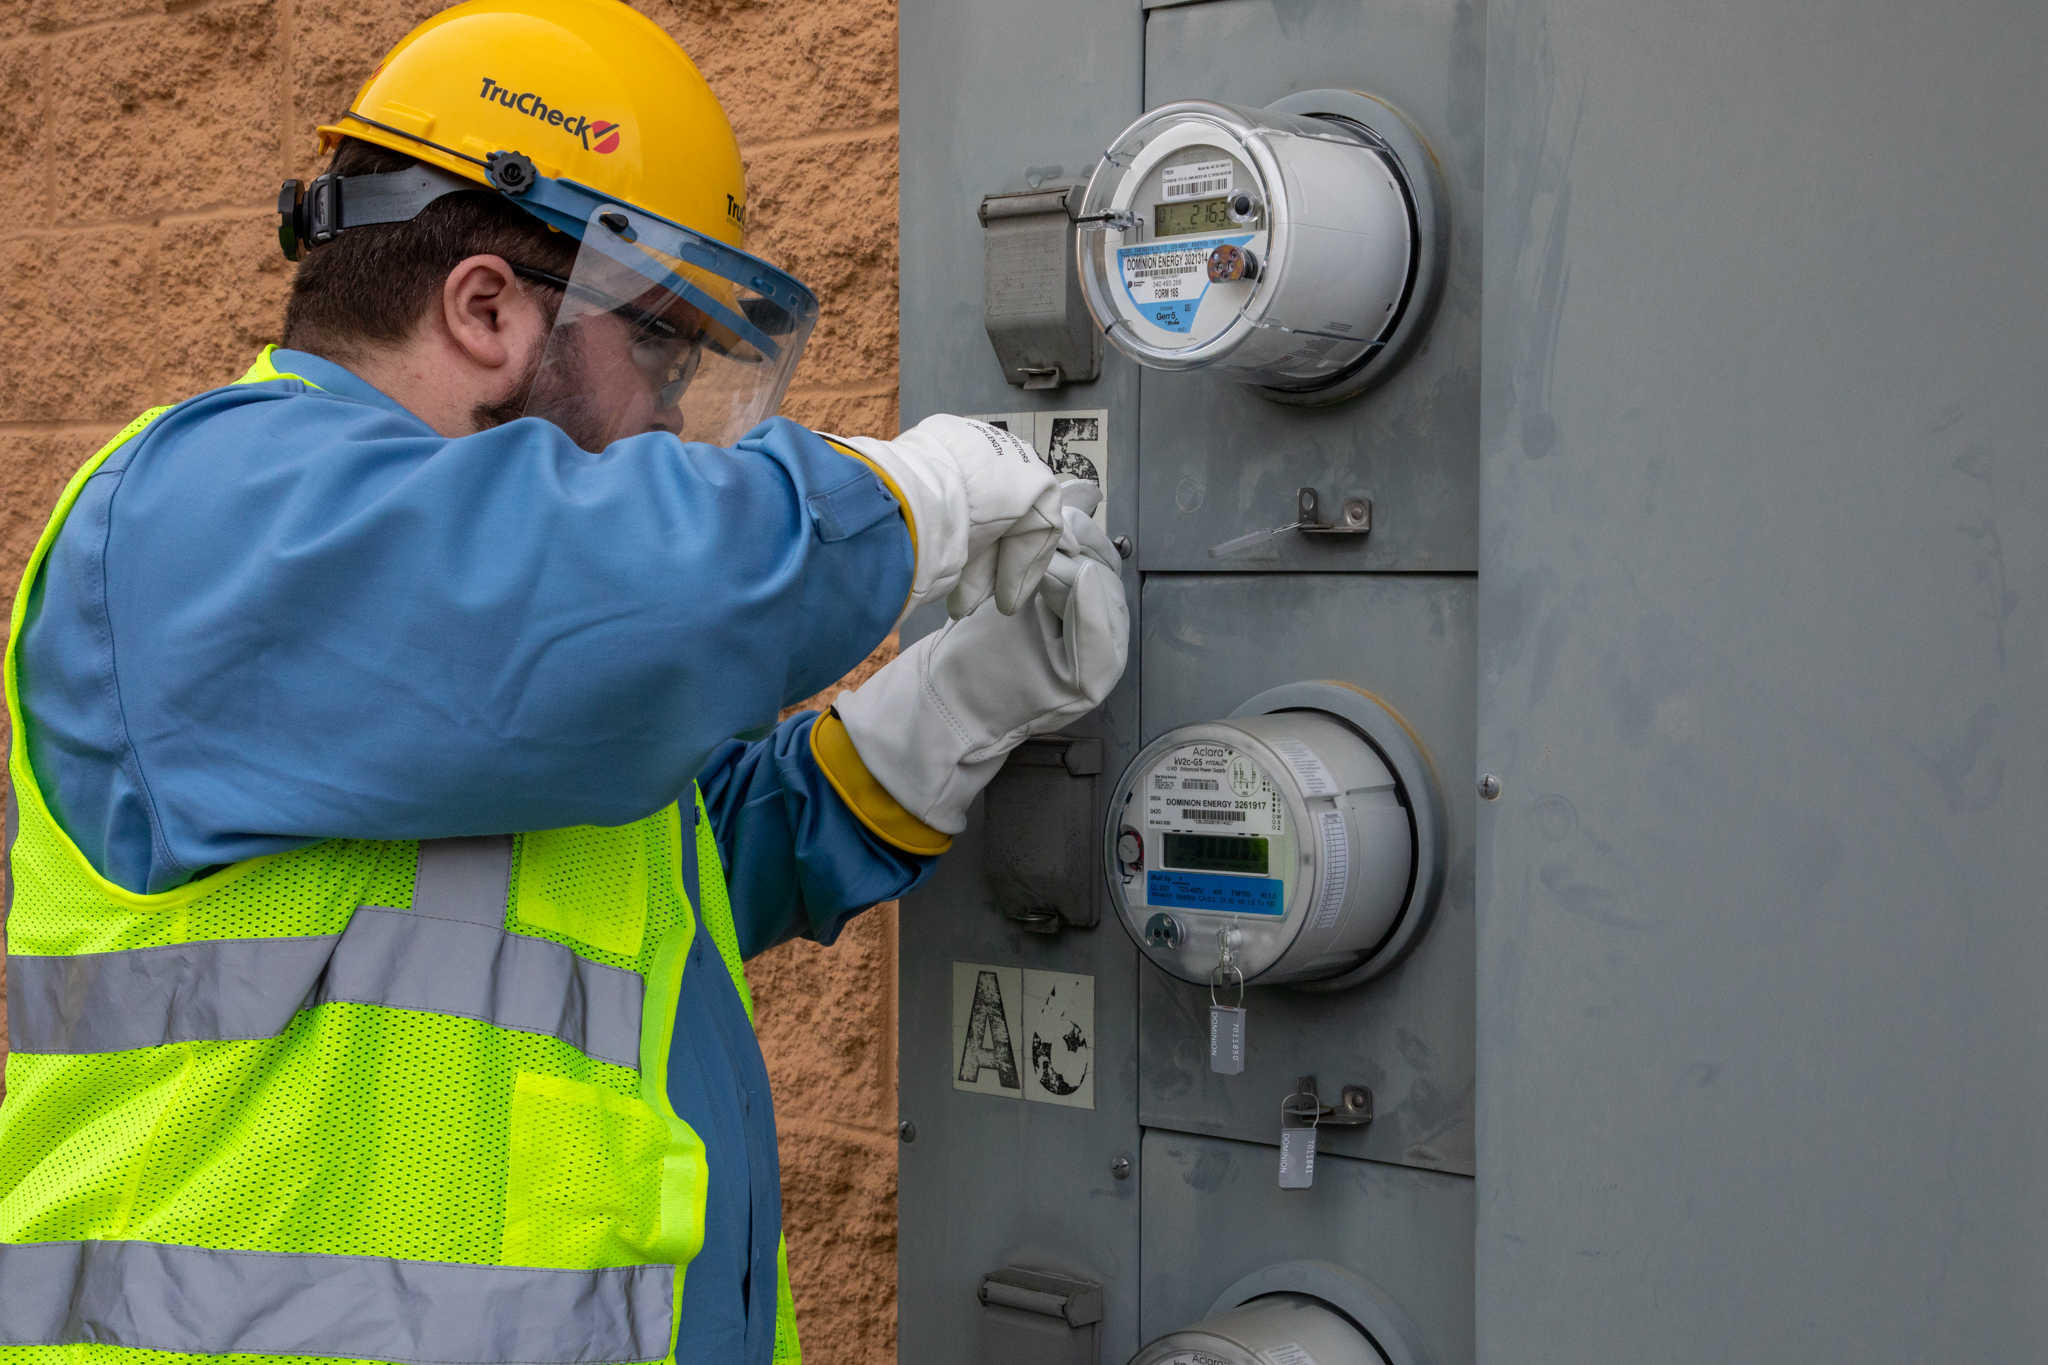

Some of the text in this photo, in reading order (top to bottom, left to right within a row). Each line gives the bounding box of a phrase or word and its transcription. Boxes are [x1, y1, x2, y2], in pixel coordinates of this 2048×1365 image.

[480, 77, 592, 151] TruCheck
[1127, 252, 1208, 271] DOMINION ENERGY 3021314
[1155, 288, 1169, 298] FORM
[655, 320, 676, 334] NEMESIS
[985, 434, 1004, 456] LENGTH
[1004, 431, 1030, 464] ROTECTORS
[1192, 747, 1224, 757] Aclara
[1174, 757, 1203, 766] kV2c-G5
[1166, 798, 1266, 810] DOMINION ENERGY 3261917
[1179, 886, 1204, 894] 120-480V
[1231, 890, 1251, 898] FM16S
[1280, 1134, 1290, 1174] DOMINION
[1305, 1140, 1314, 1174] 7011841
